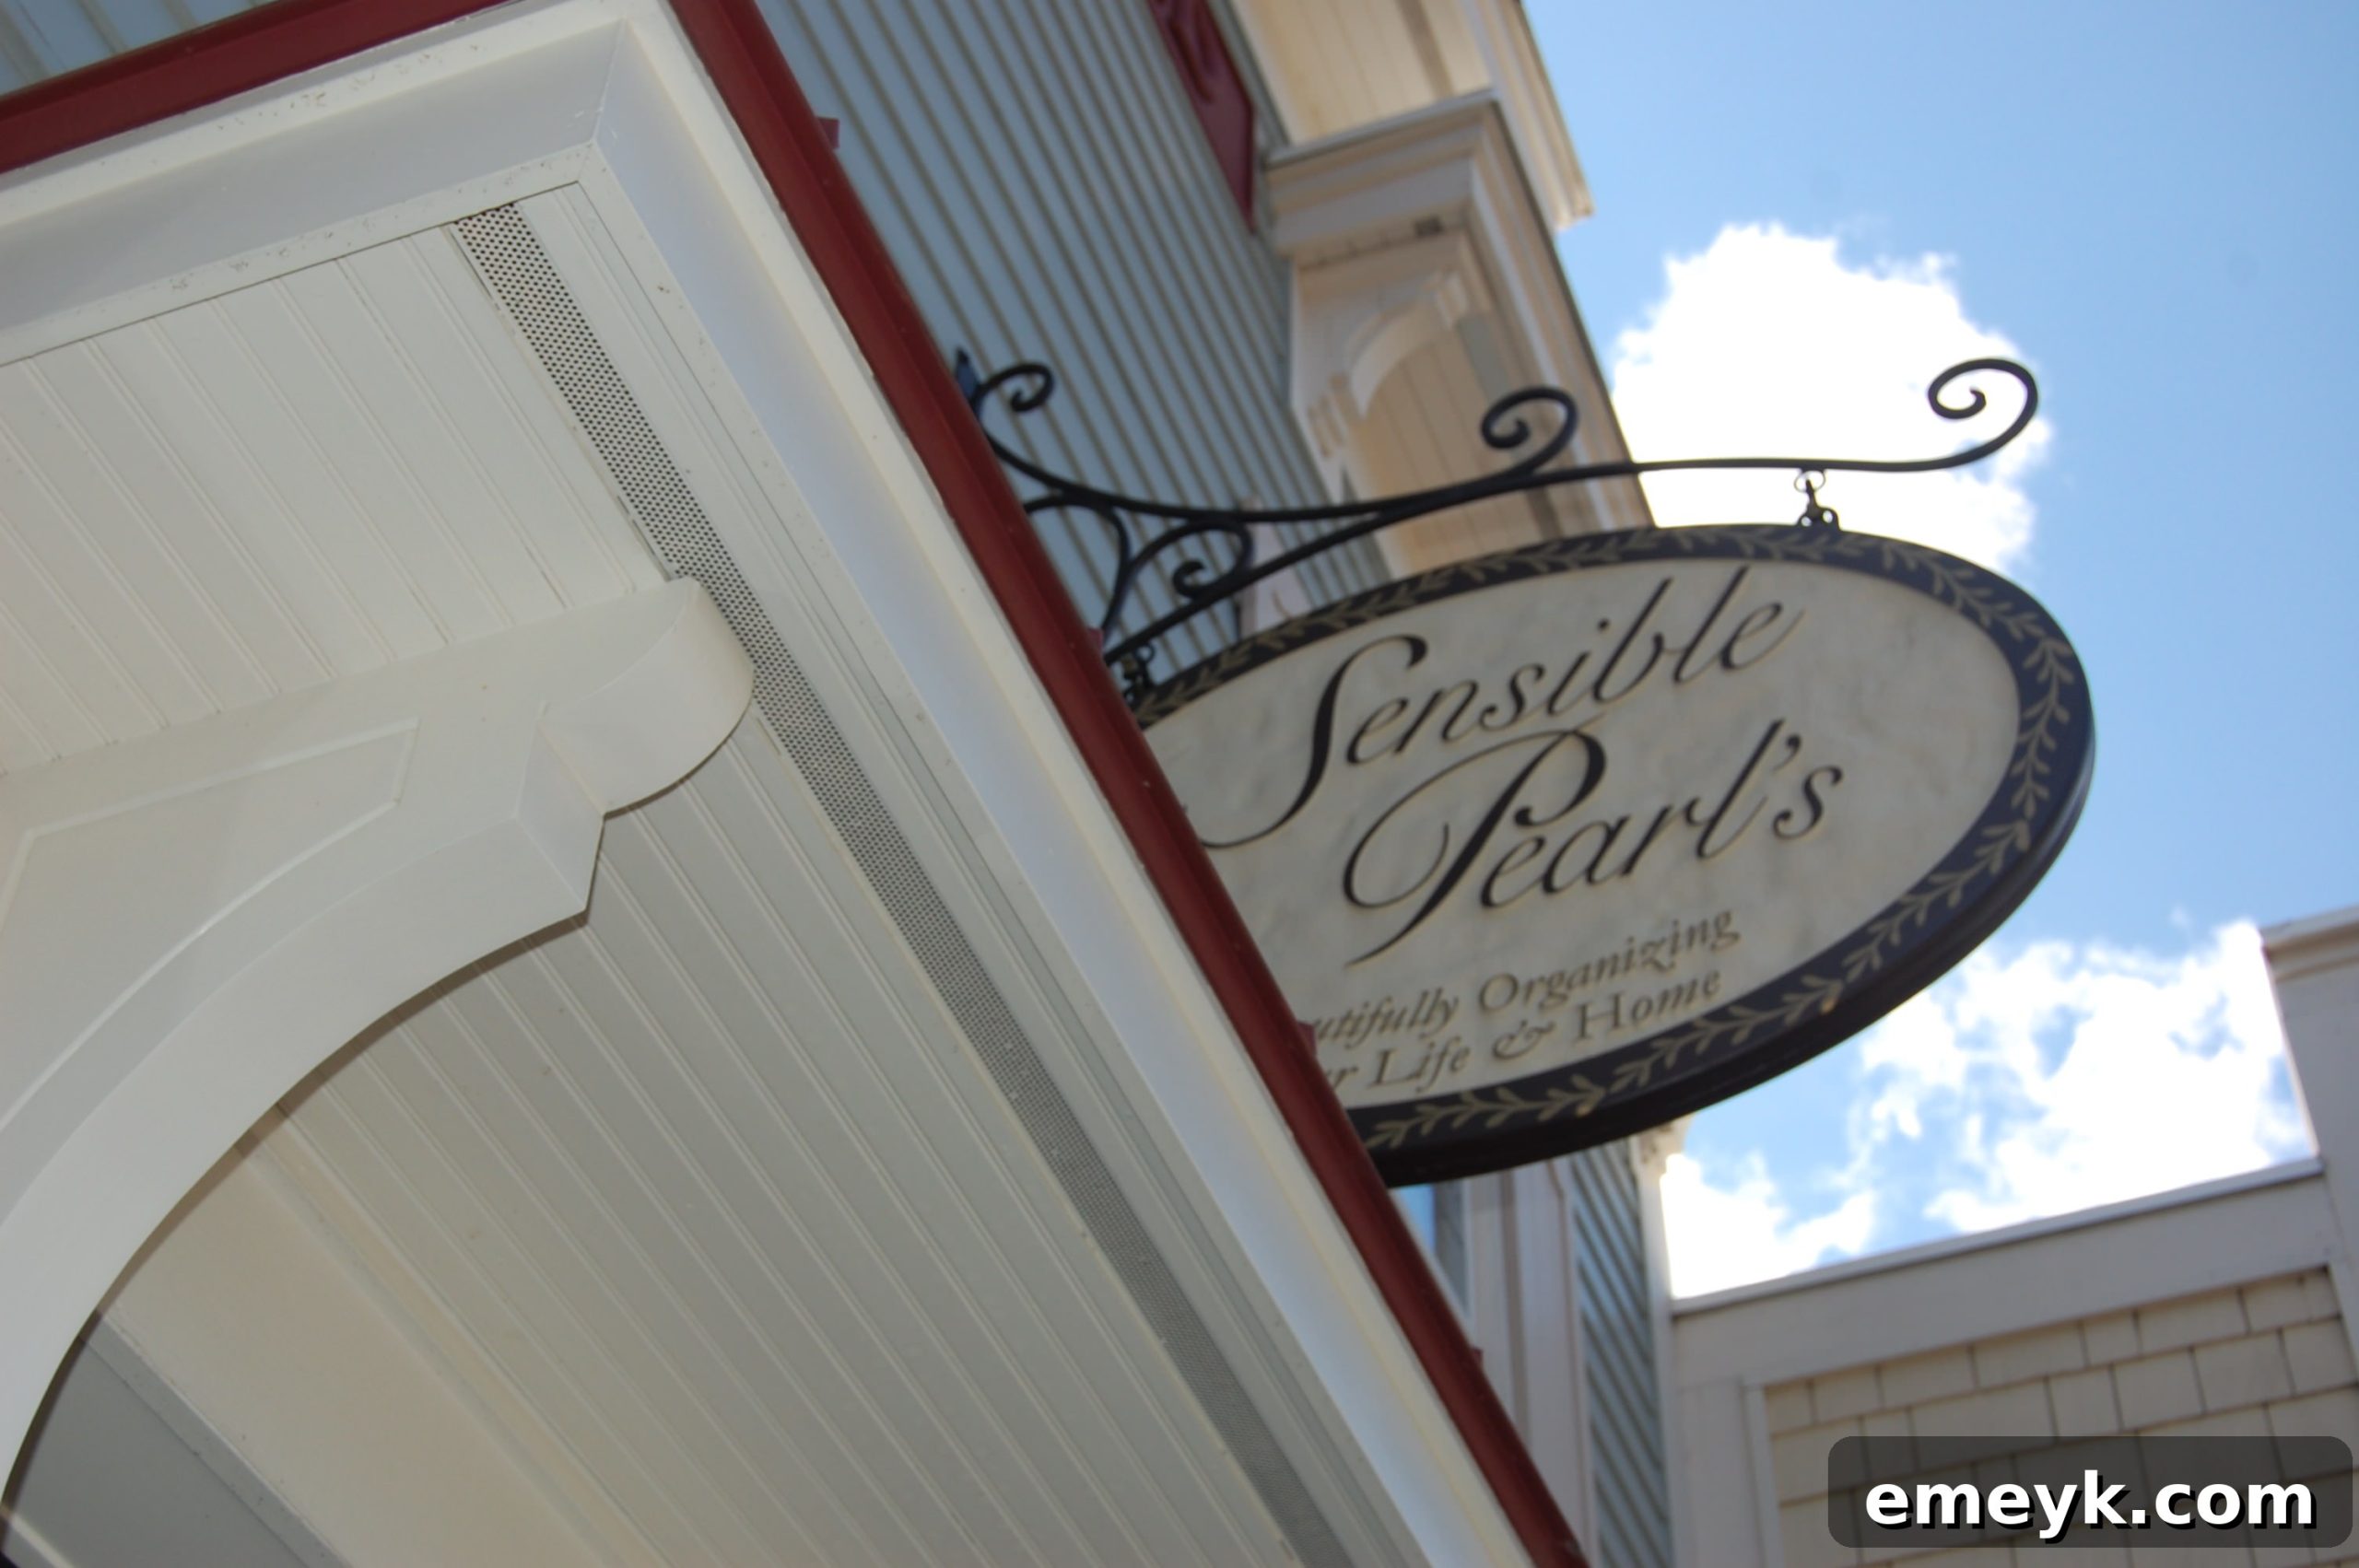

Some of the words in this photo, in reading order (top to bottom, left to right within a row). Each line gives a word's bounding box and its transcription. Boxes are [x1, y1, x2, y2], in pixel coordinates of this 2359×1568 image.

[1201, 565, 1805, 848] Sensible
[1343, 713, 1844, 968] Pearl's
[1366, 1035, 1471, 1094] Life
[1491, 1018, 1557, 1060] &
[1570, 969, 1721, 1045] Home
[1478, 909, 1741, 1012] Organizing
